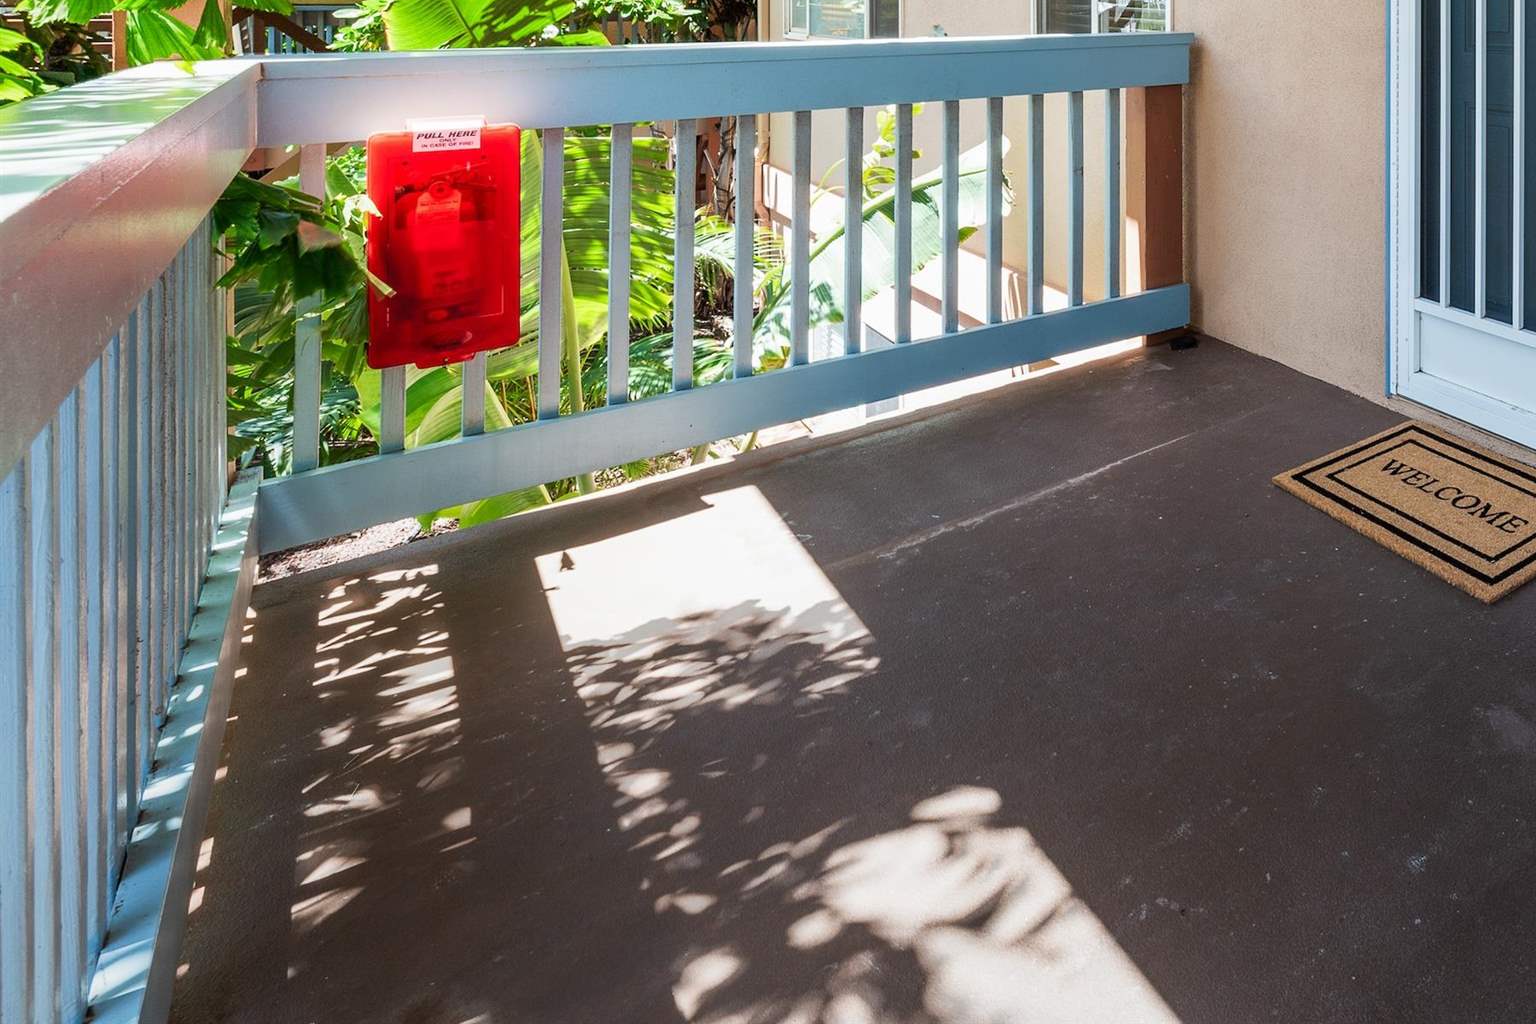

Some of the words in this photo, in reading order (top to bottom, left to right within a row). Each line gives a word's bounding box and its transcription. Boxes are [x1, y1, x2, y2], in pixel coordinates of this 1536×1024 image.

[416, 132, 444, 140] PULL
[448, 130, 478, 138] HERE
[1381, 459, 1529, 533] WELCOME
